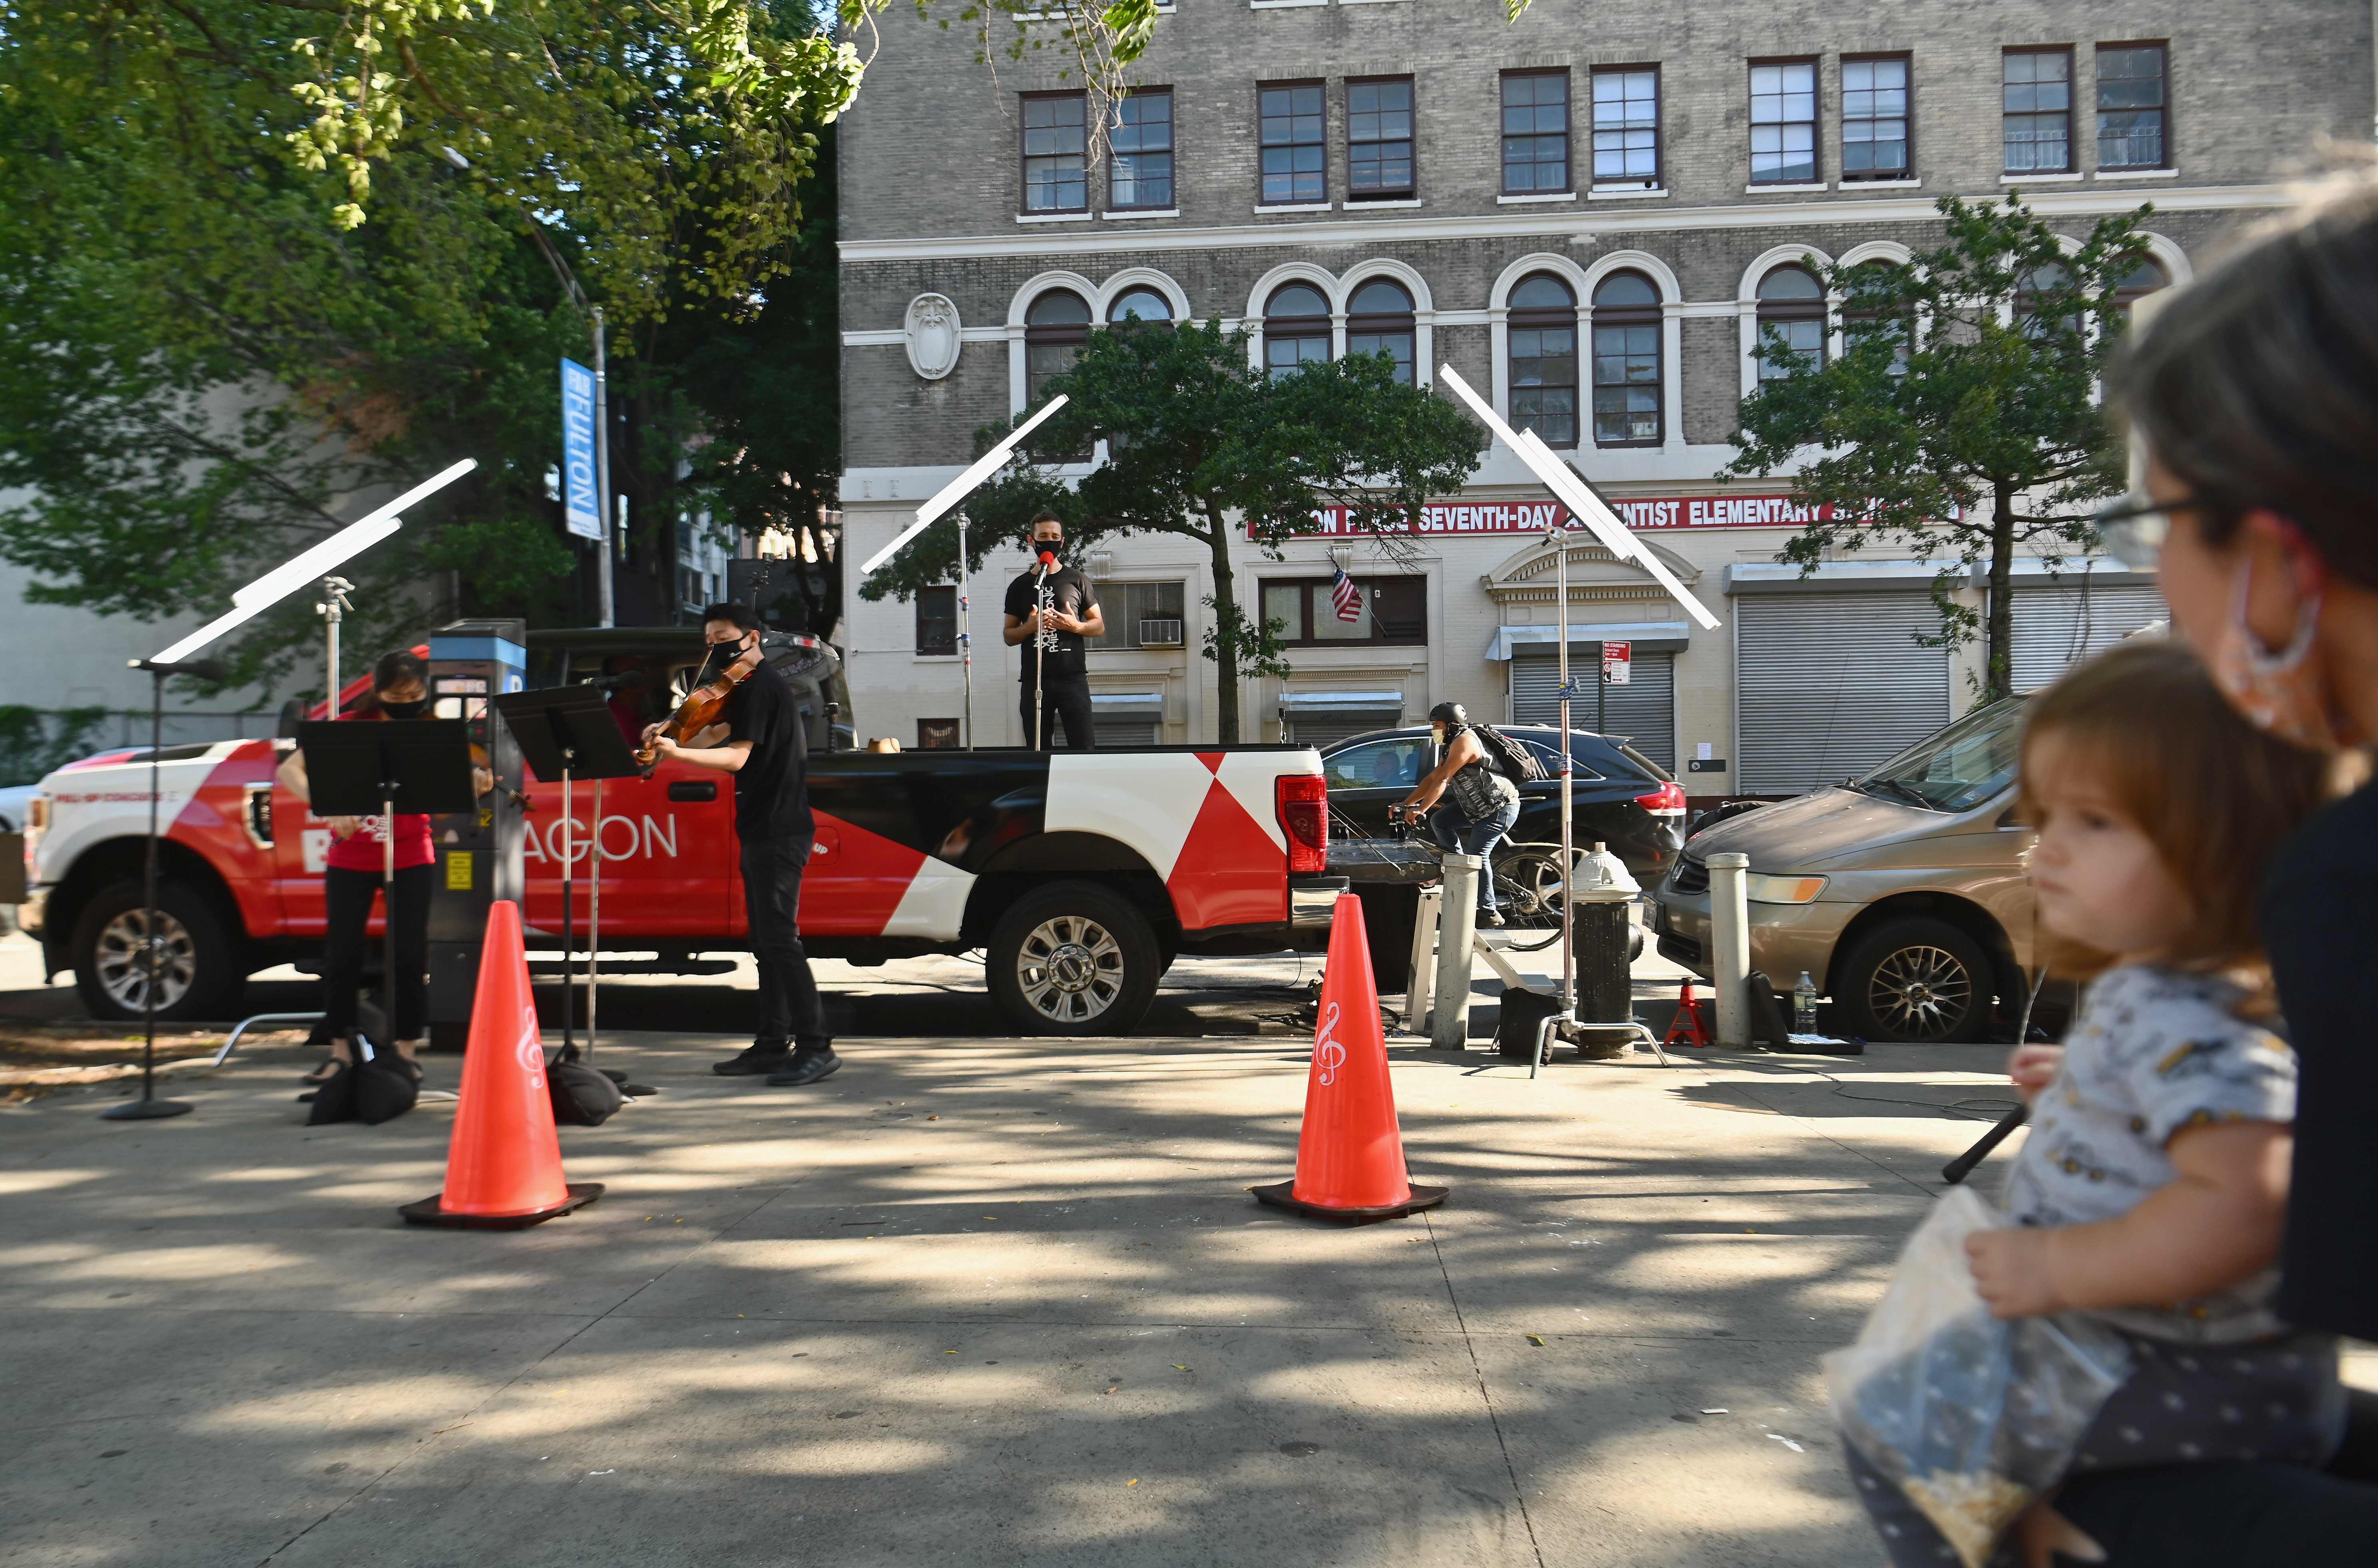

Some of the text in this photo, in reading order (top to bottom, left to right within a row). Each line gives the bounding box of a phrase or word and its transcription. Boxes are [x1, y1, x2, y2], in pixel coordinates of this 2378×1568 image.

[568, 390, 593, 509] FULTON
[1418, 505, 1556, 531] SEVENTH-DAY
[1565, 502, 1680, 528] ANTIST
[1690, 498, 1821, 525] ELEMENTARY
